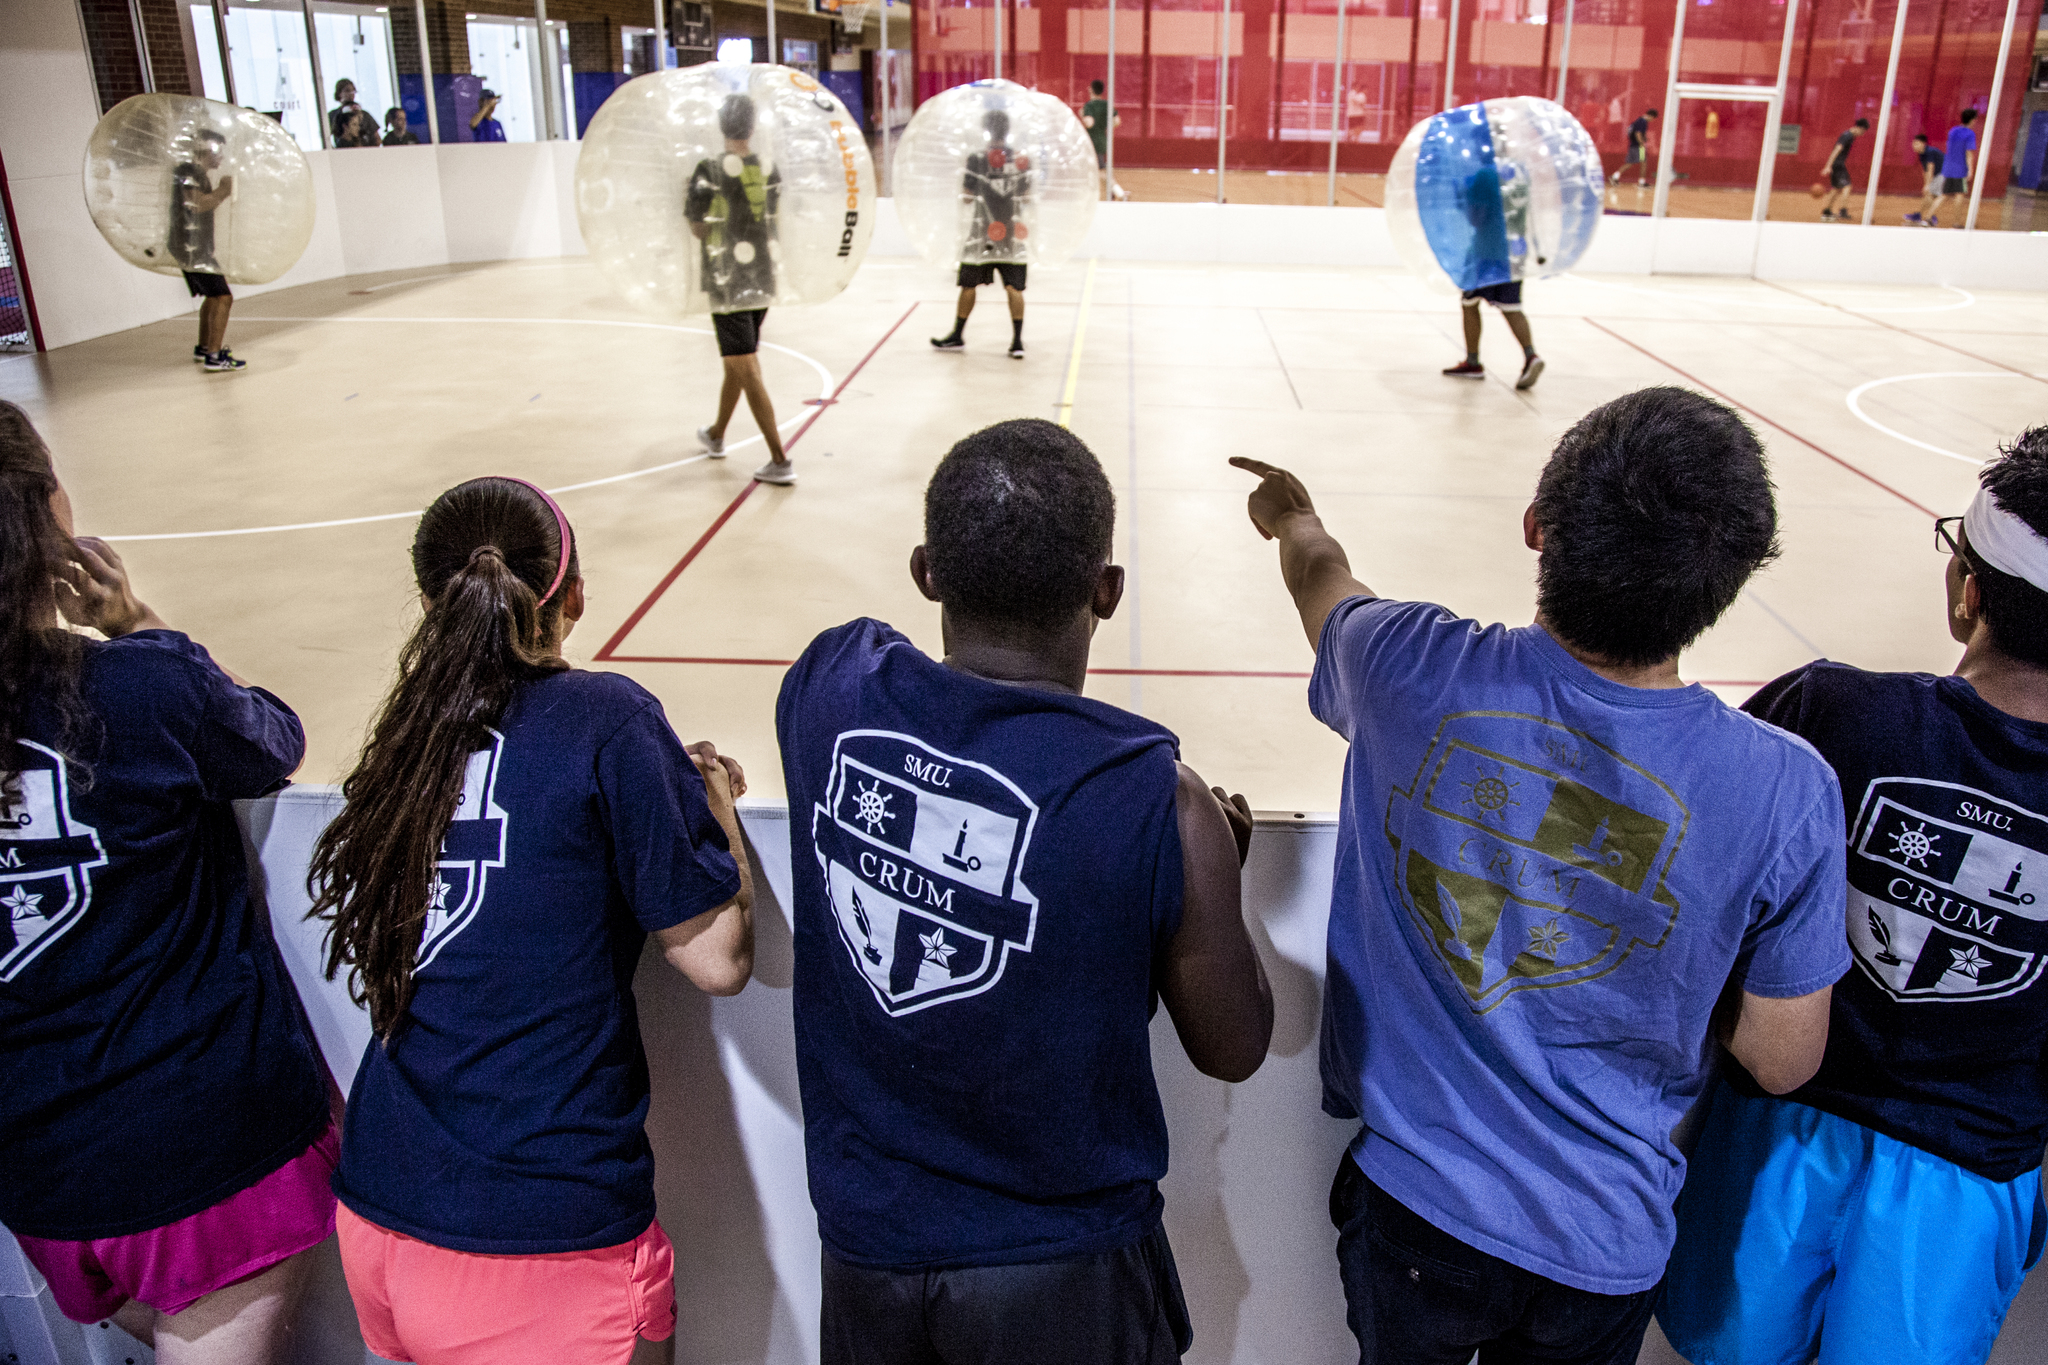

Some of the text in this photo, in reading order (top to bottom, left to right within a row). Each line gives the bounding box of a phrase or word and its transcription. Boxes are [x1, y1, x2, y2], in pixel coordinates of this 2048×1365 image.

[859, 851, 956, 914] CRUM
[1459, 838, 1581, 899] CRUM
[1887, 877, 2003, 936] CRUM
